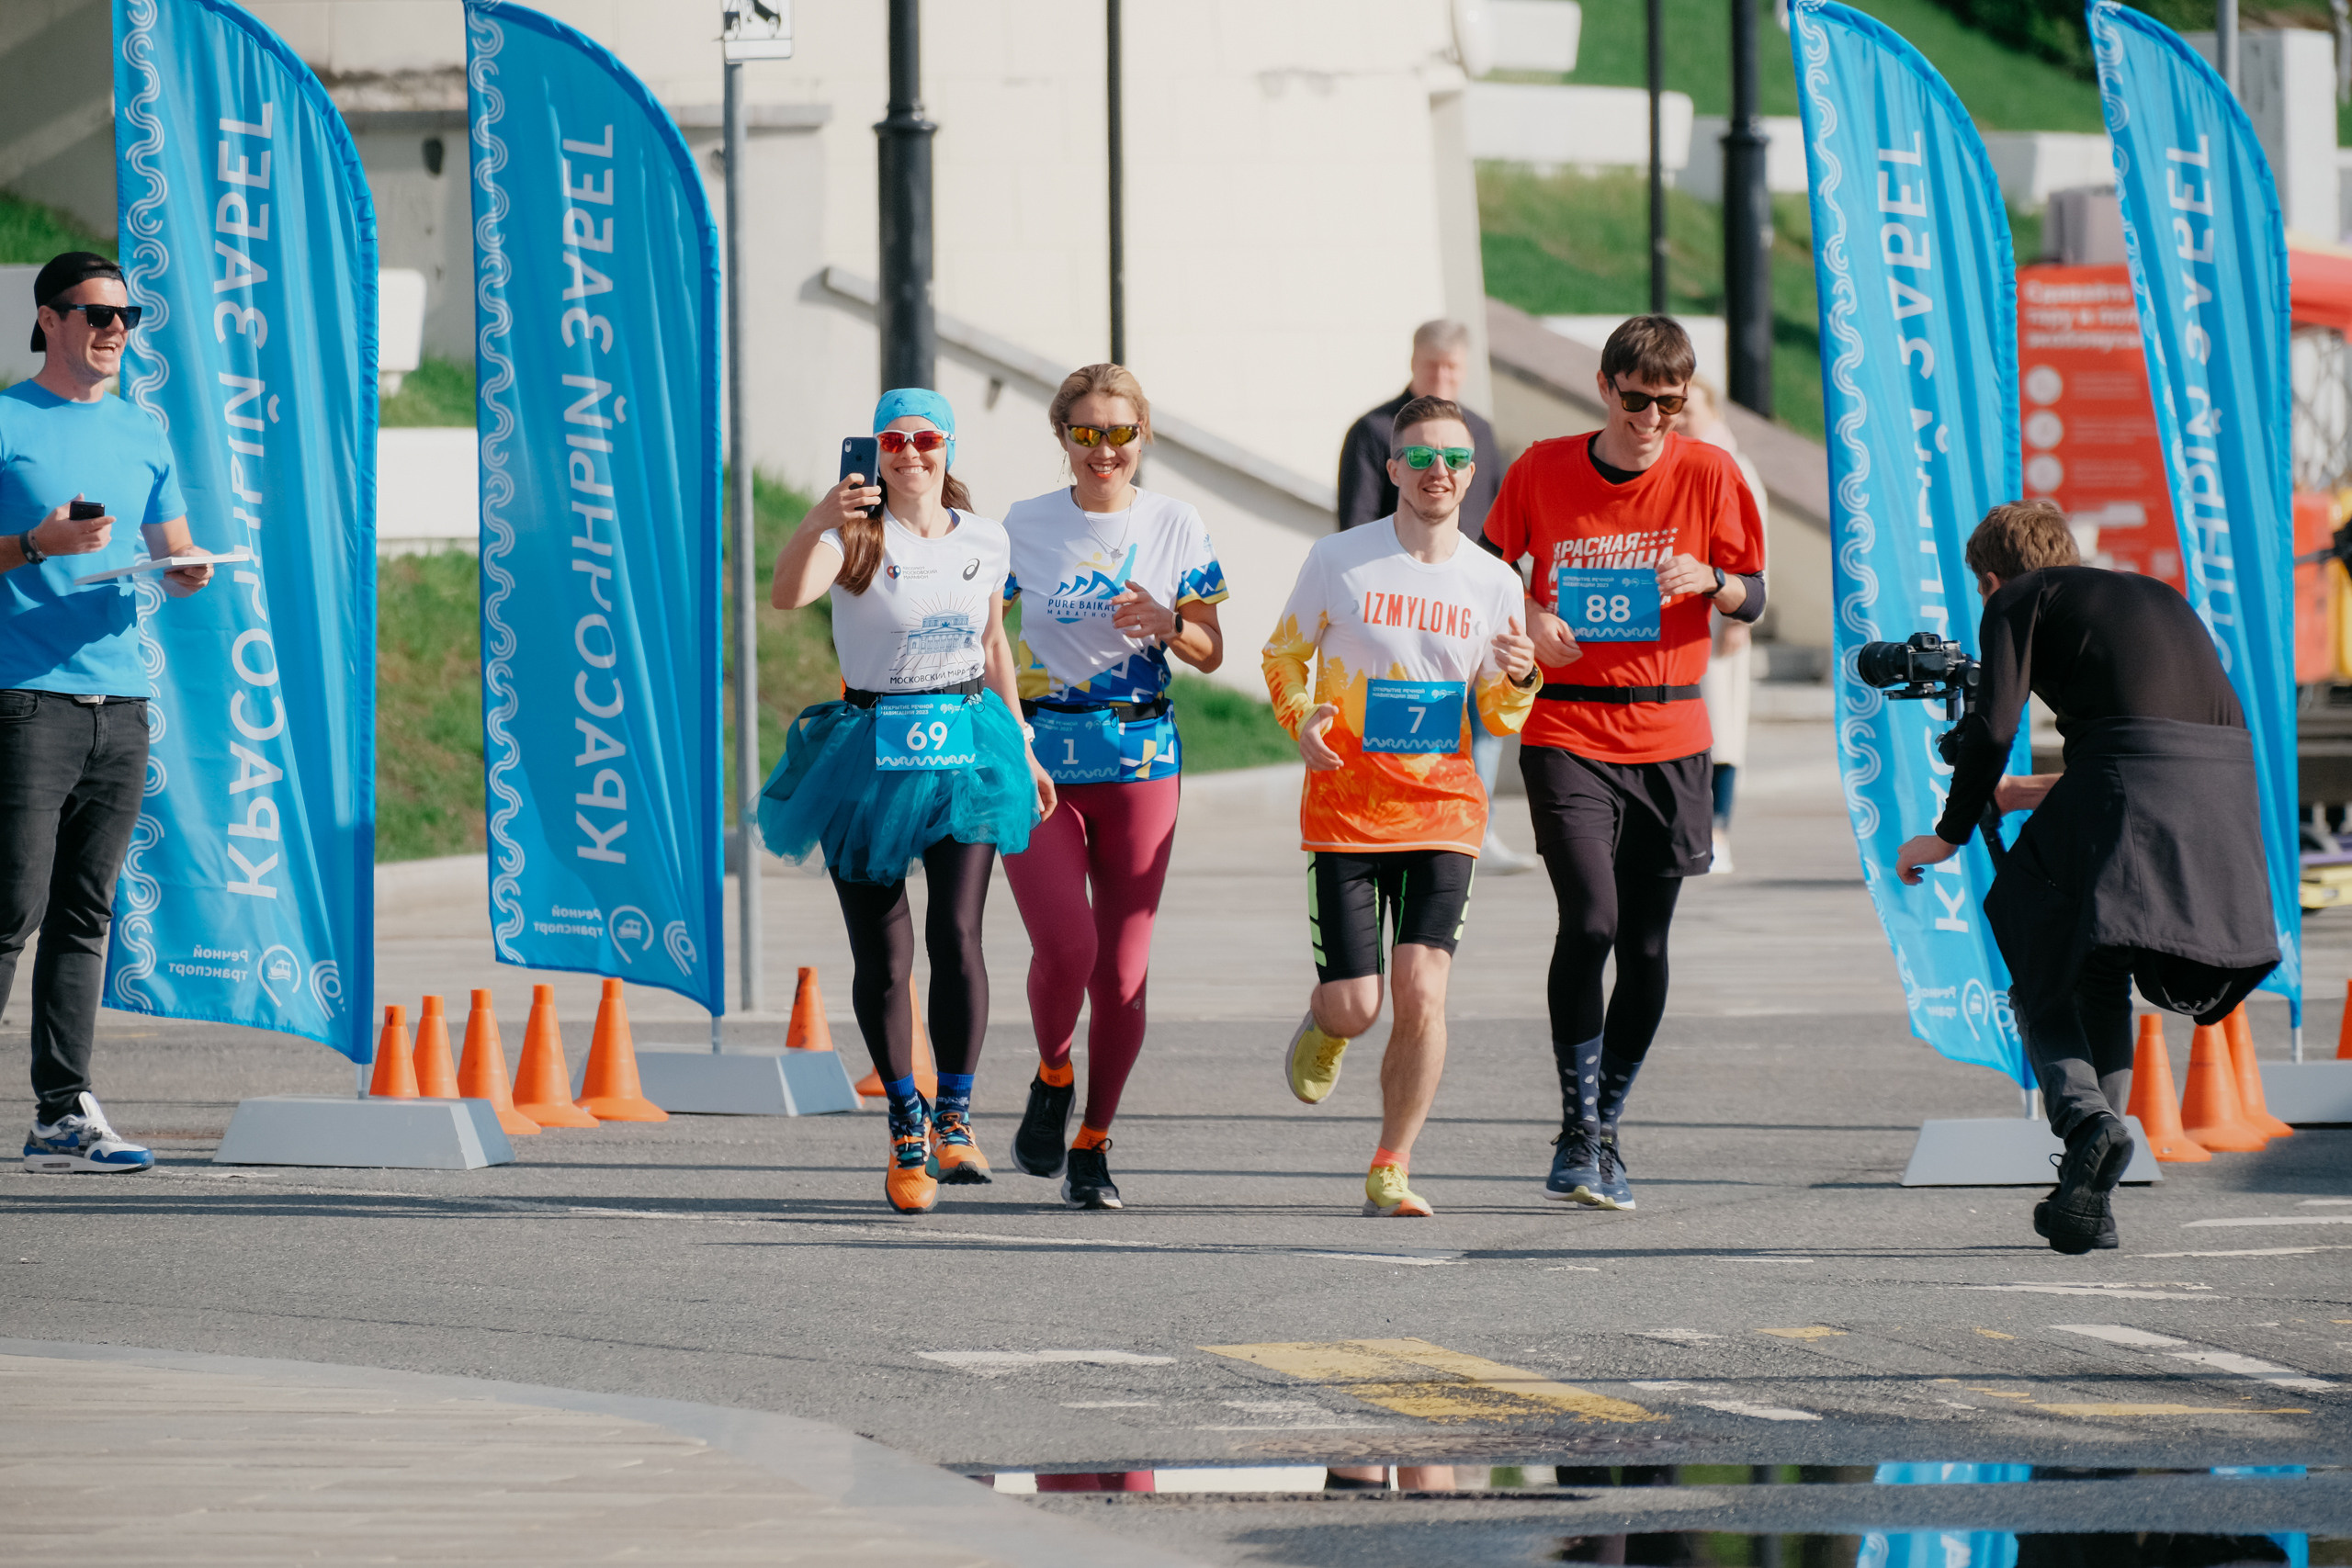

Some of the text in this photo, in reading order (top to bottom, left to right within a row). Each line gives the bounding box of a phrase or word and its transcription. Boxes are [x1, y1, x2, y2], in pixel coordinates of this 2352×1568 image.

[1553, 533, 1643, 561] КРАСНАЯ
[1048, 599, 1076, 609] PURE
[1363, 592, 1472, 639] IZMYLONG
[1586, 594, 1631, 623] 88
[1408, 706, 1426, 734] 7
[906, 721, 948, 751] 69
[1062, 739, 1080, 765] 1
